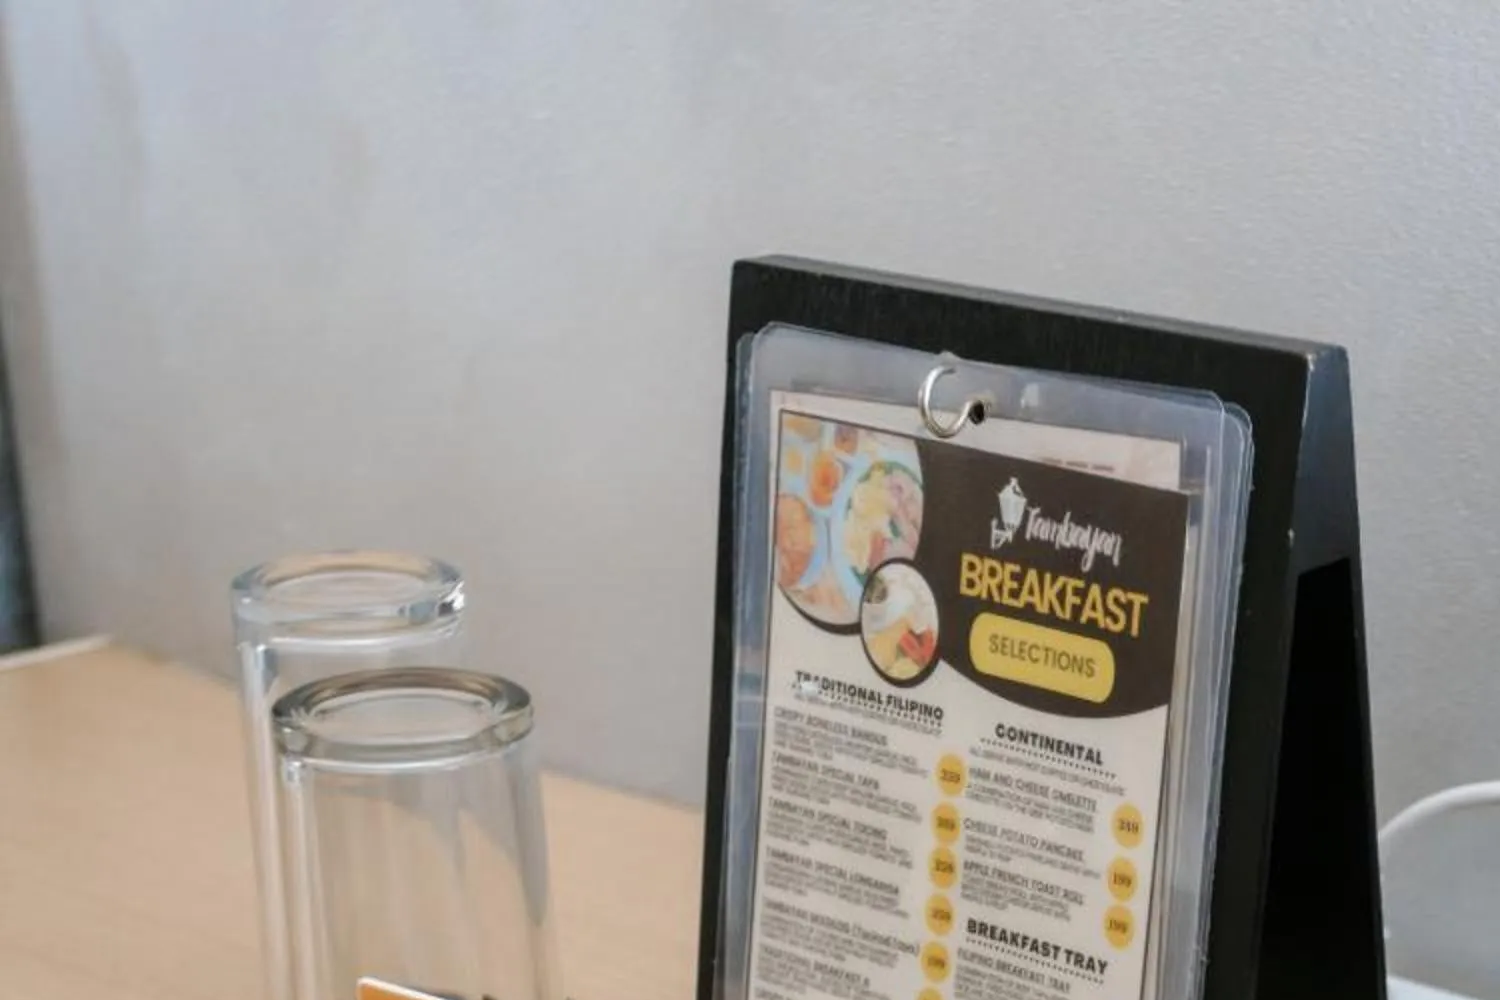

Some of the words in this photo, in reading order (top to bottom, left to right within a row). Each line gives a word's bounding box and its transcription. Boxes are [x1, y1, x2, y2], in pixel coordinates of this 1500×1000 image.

[960, 553, 1148, 637] BREAKFAST
[988, 633, 1096, 678] SELECTIONS
[886, 694, 944, 719] FILIPINO
[995, 723, 1104, 765] CONTINENTAL
[993, 773, 1014, 787] AND
[1000, 826, 1039, 848] POTATO
[967, 918, 1062, 959] BREAKFAST
[1064, 949, 1108, 975] TRAY
[995, 958, 1045, 984] BREAKFAST
